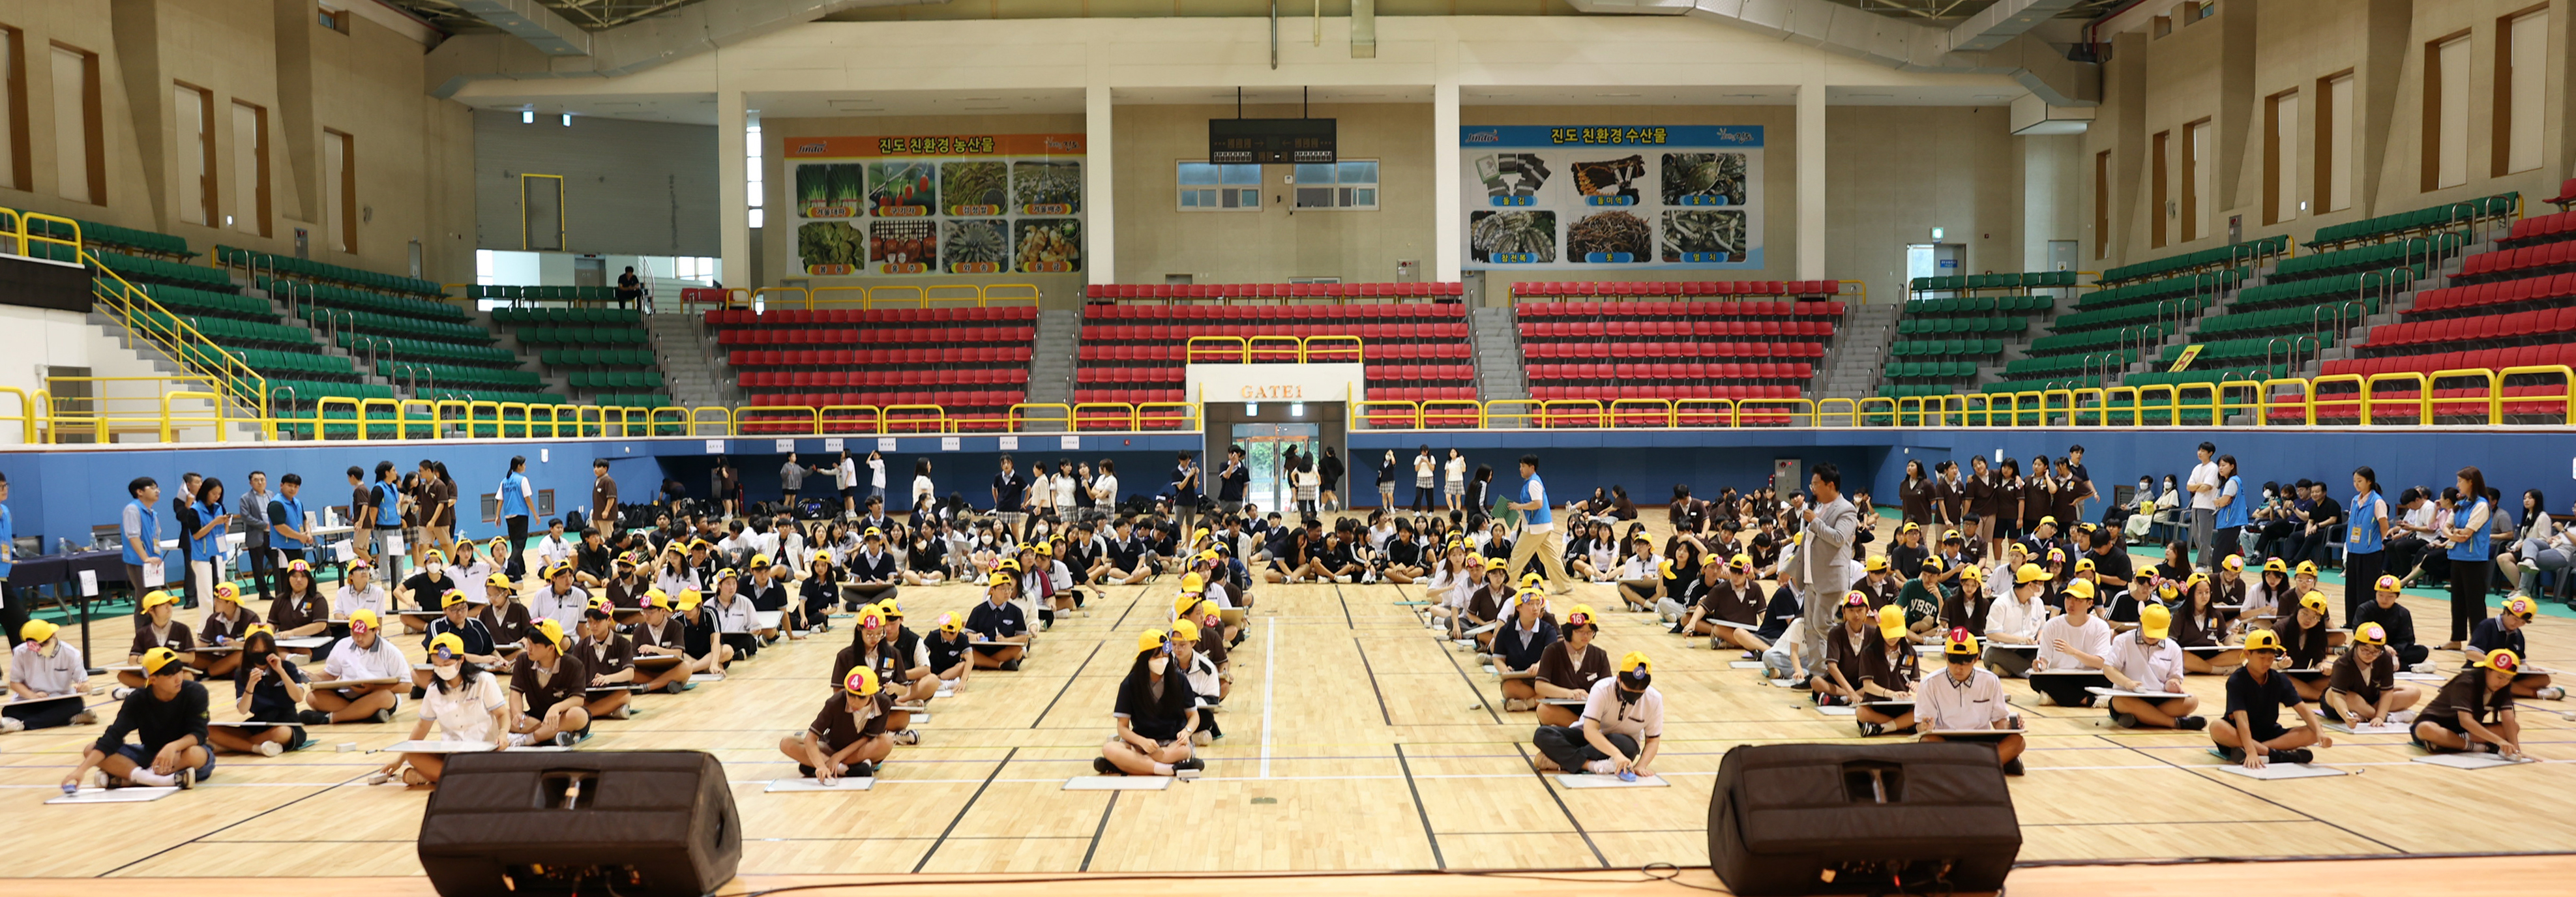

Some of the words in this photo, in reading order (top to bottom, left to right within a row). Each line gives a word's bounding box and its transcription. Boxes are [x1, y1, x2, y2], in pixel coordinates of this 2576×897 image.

[1466, 133, 1494, 143] Jindo
[1551, 128, 1578, 144] 진도
[1582, 128, 1623, 143] 친환경
[1625, 128, 1667, 144] 수산물
[796, 144, 824, 154] Jindo
[880, 138, 906, 154] 진도
[910, 138, 949, 154] 친환경
[953, 137, 994, 154] 농산물
[890, 207, 915, 215] 구기자
[1501, 254, 1527, 263] 참전복
[1241, 385, 1303, 398] GATE1
[295, 563, 304, 571] 51
[2381, 578, 2391, 586] 40
[641, 596, 650, 608] 33
[1850, 593, 1861, 604] 27
[601, 602, 612, 613] 23
[2513, 601, 2524, 611] 30
[866, 616, 877, 628] 14
[1206, 615, 1217, 626] 35
[1571, 614, 1582, 624] 16
[353, 621, 364, 634] 22
[2370, 628, 2380, 638] 19
[1954, 628, 1962, 641] 7
[2496, 655, 2508, 667] 9
[850, 675, 859, 688] 4
